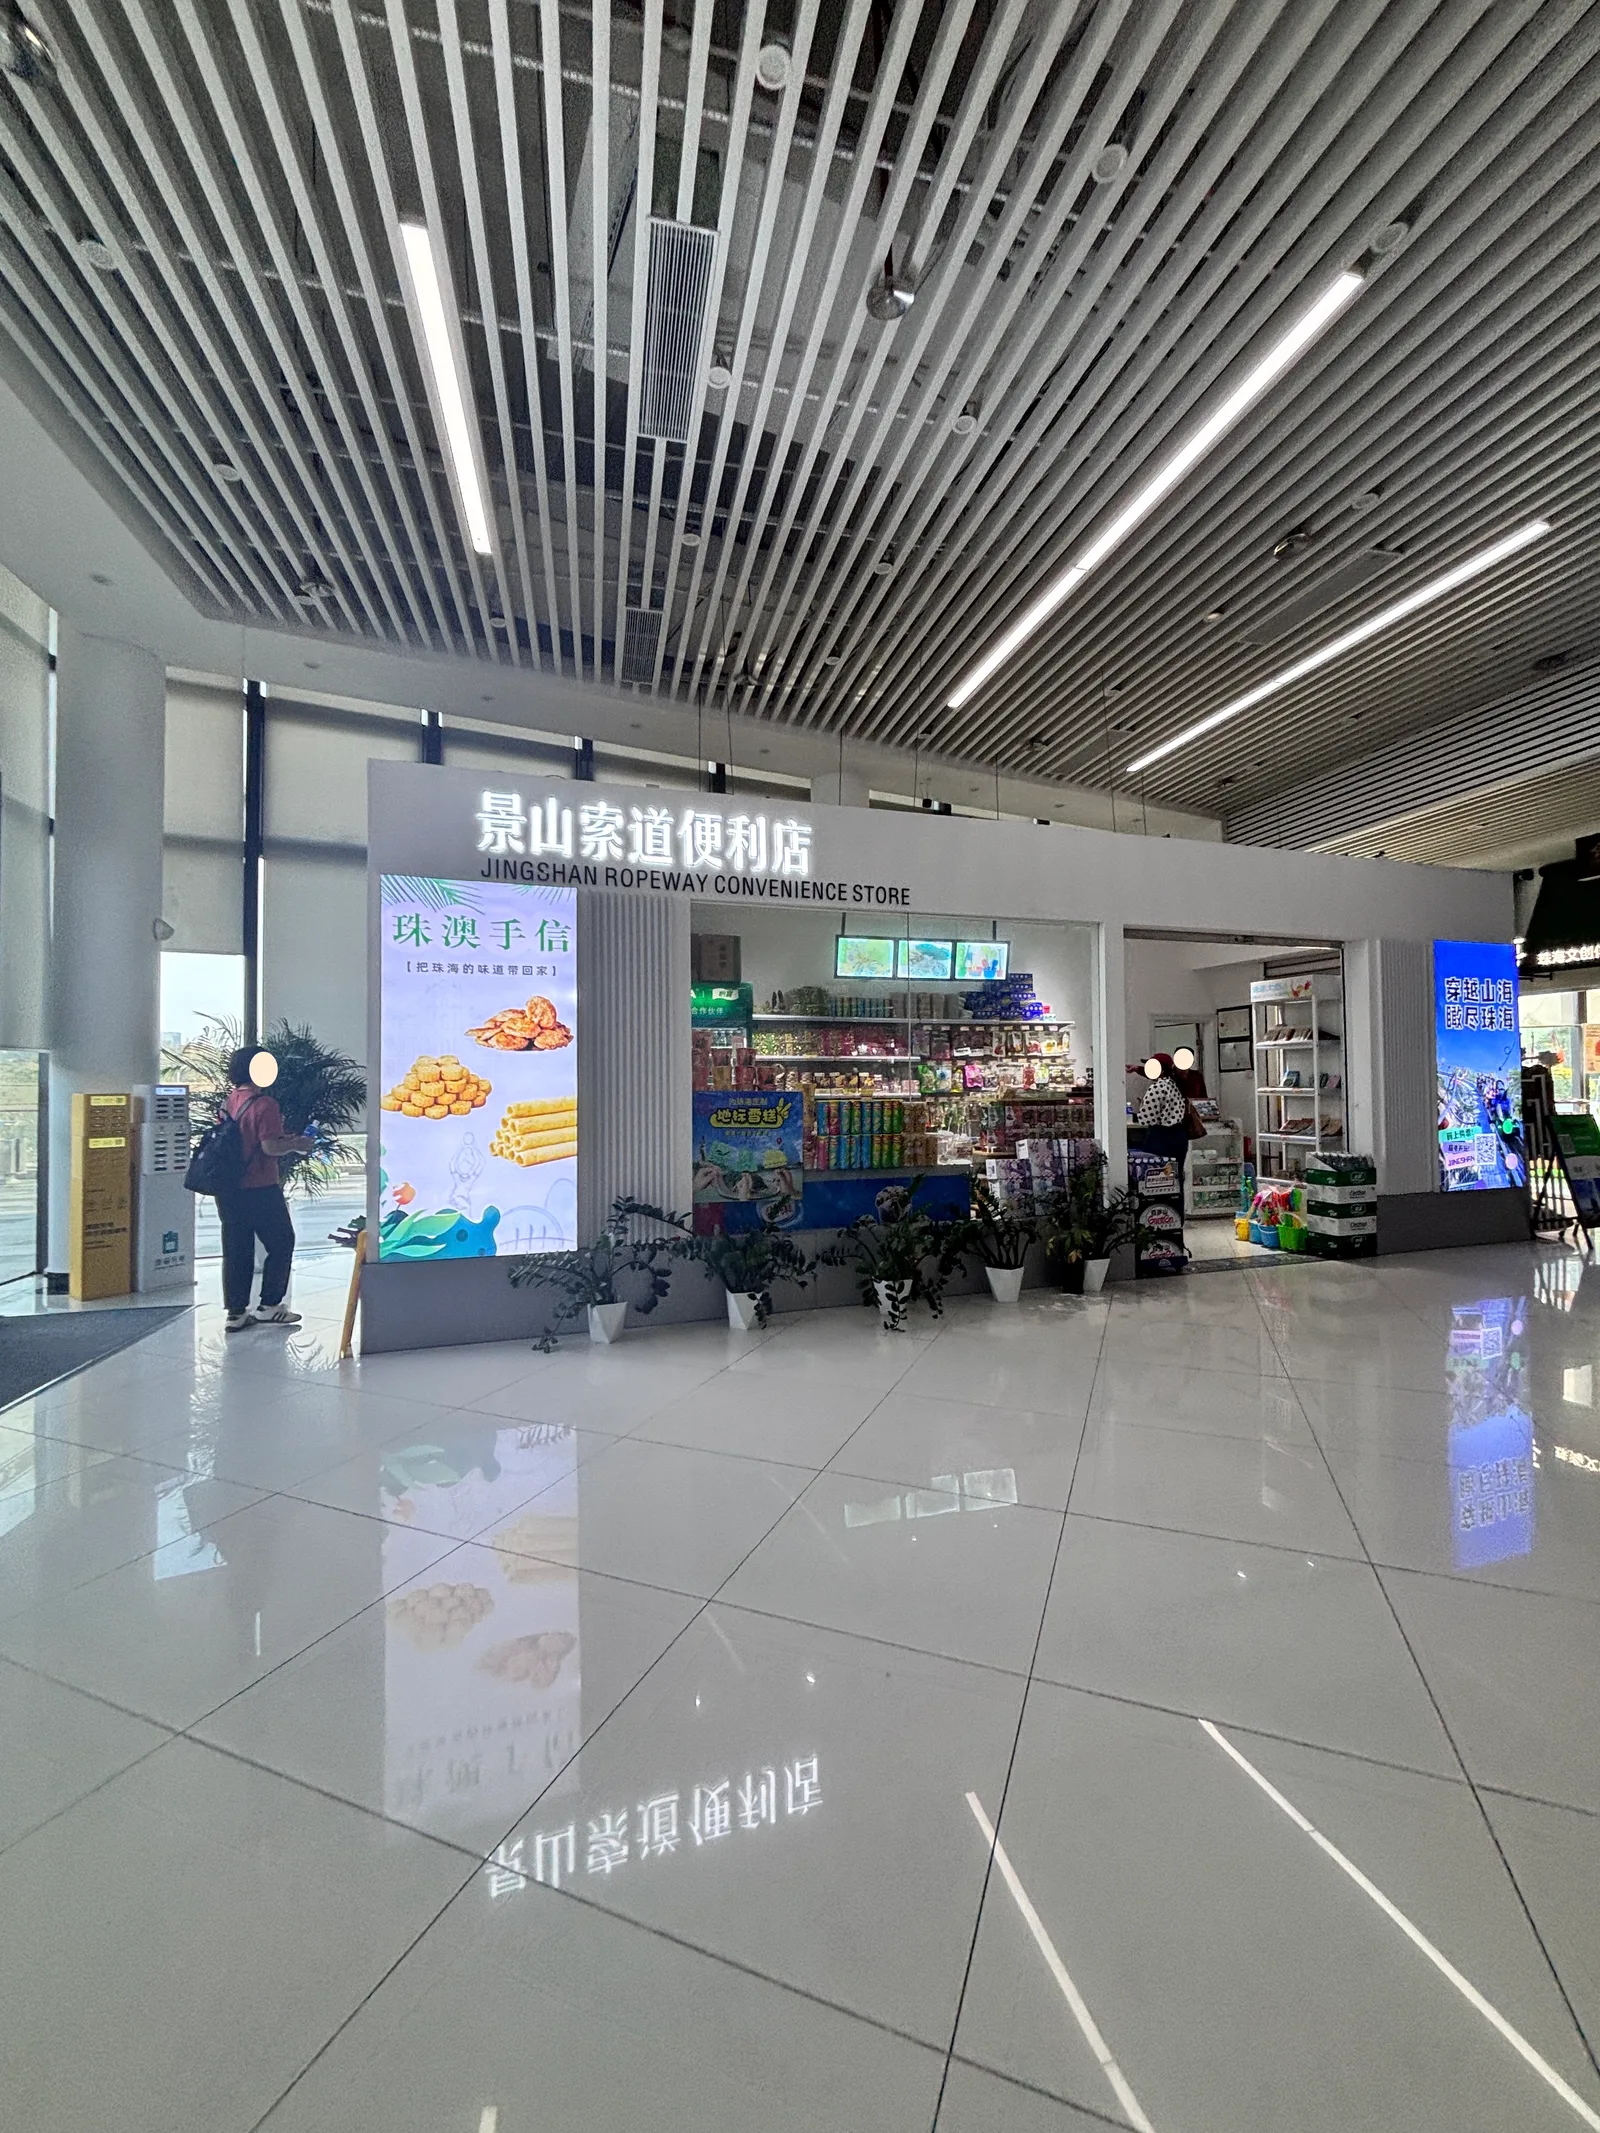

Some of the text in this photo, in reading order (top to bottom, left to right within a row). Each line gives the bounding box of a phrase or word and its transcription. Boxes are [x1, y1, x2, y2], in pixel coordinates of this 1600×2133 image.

[476, 790, 813, 875] 景山索道便利店
[481, 858, 910, 905] JINGSHAN ROPEWAY CONVENIENCE STORE
[392, 913, 571, 952] 珠澳手信
[1445, 976, 1513, 1004] 穿越山海
[1445, 1004, 1514, 1031] 瞰尽珠海
[716, 1107, 778, 1124] 地标雪糕
